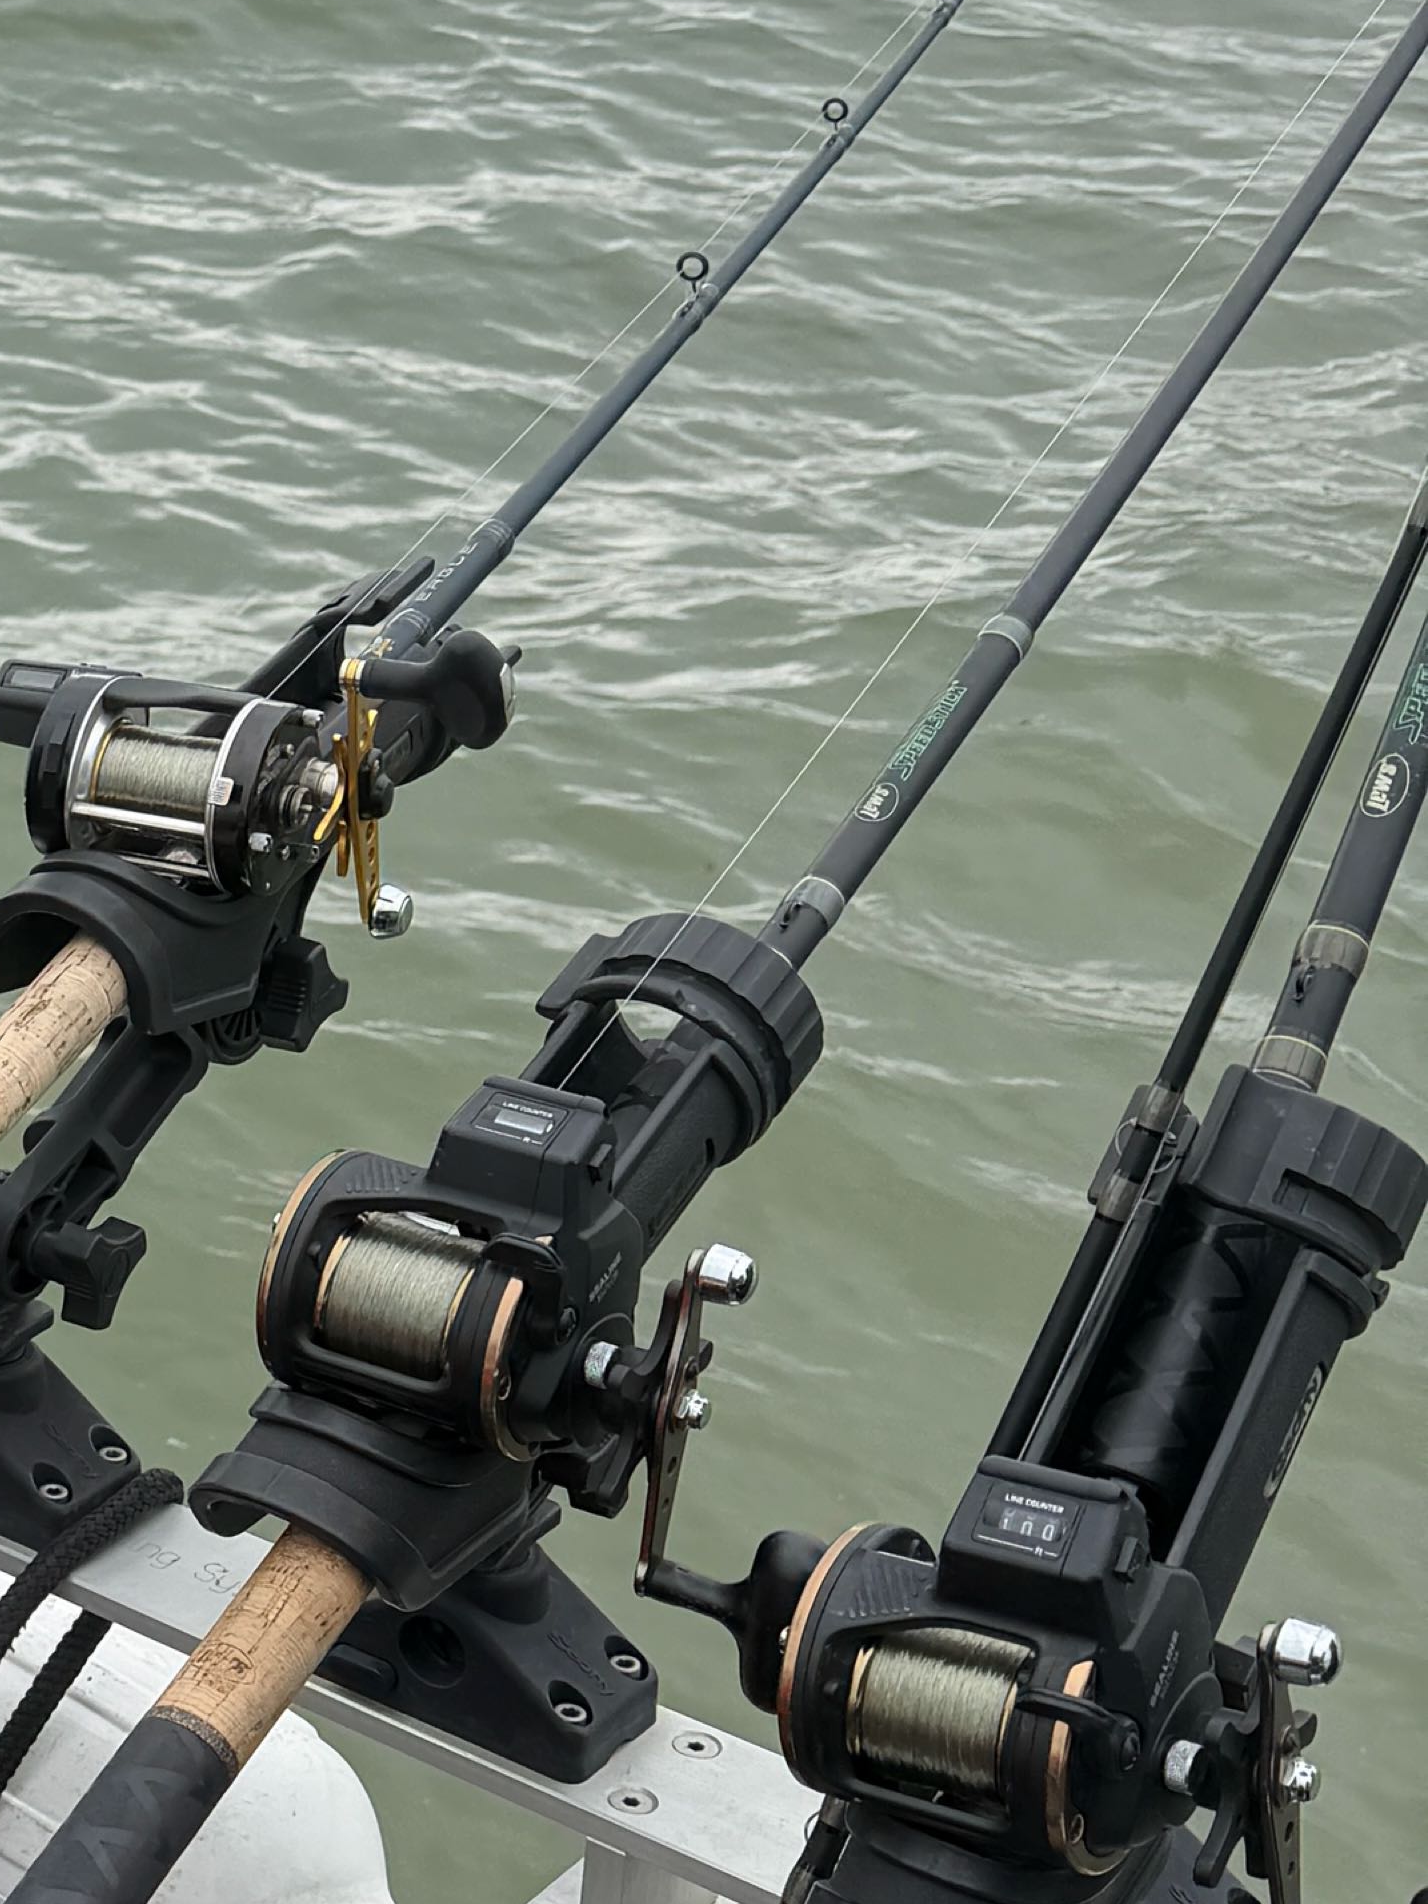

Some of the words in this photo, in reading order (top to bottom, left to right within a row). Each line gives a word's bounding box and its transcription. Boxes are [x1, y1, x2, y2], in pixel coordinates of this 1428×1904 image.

[415, 542, 479, 602] EAGLE
[1005, 1493, 1024, 1505] LINE
[1025, 1498, 1064, 1514] COUNTER
